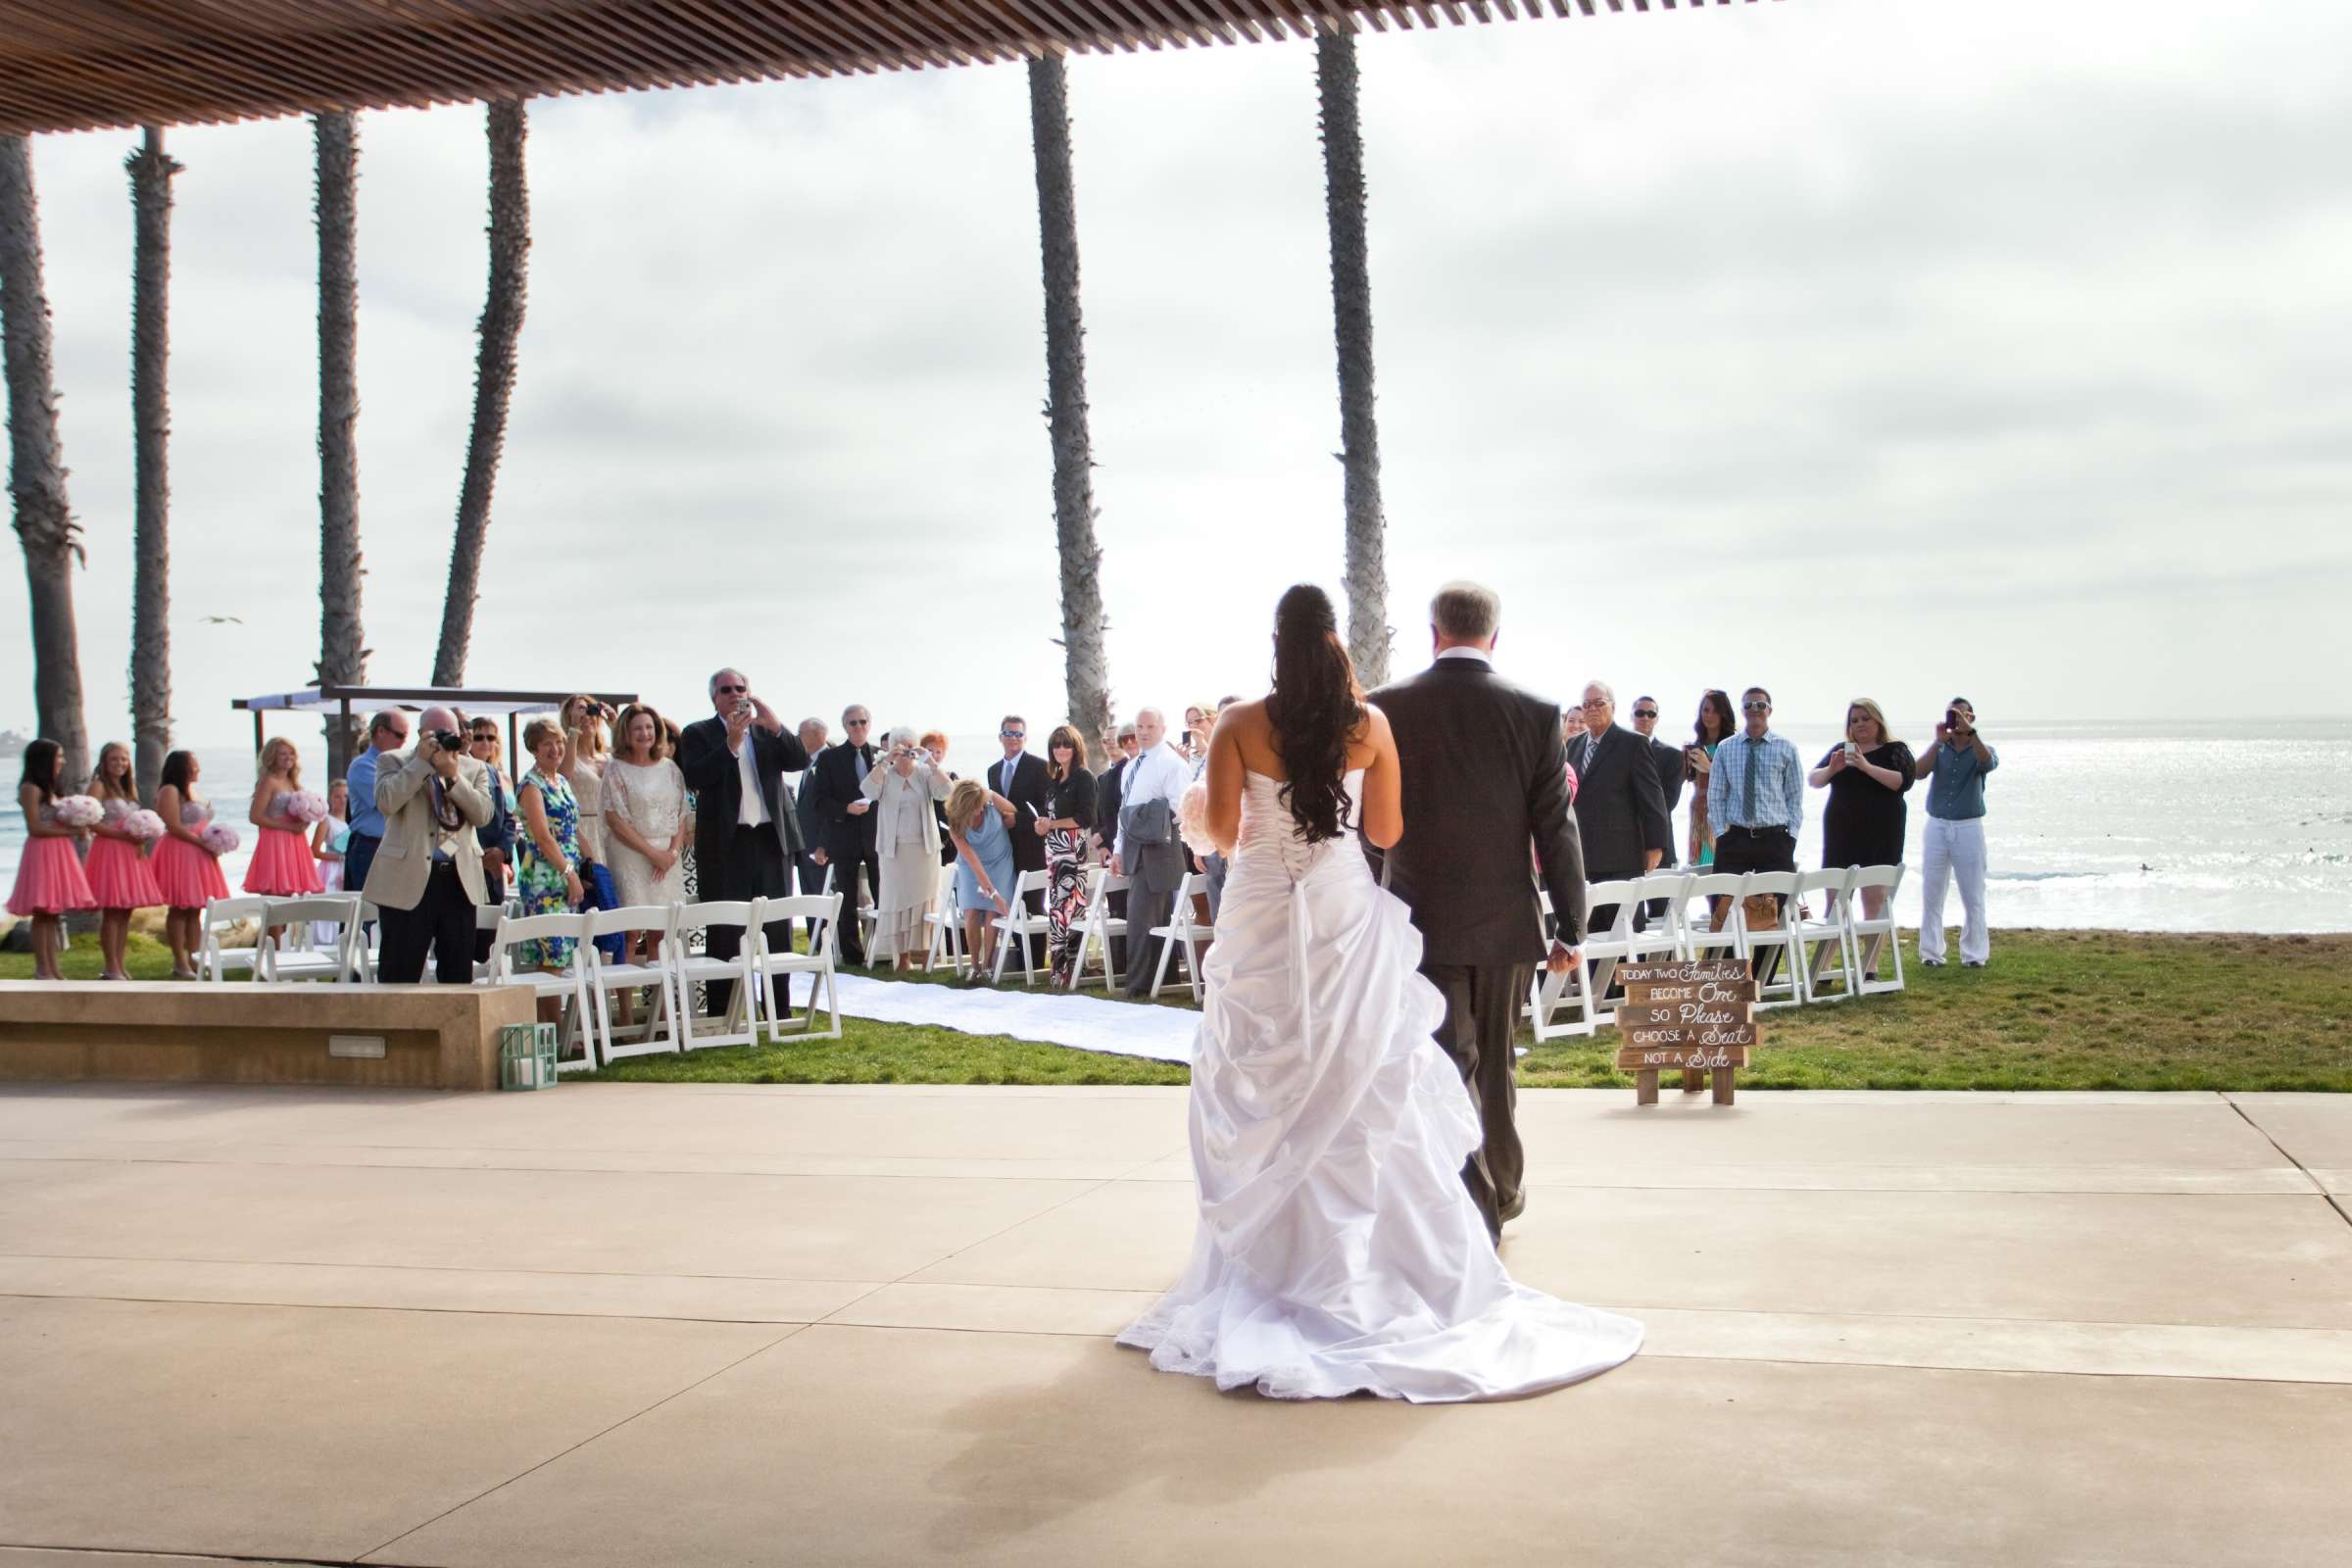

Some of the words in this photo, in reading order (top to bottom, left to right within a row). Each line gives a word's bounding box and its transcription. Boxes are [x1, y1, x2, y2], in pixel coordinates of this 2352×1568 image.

[1621, 969, 1652, 980] TODAY
[1679, 961, 1744, 982] Families
[1650, 988, 1691, 1000] BECOME
[1698, 983, 1737, 1003] One
[1650, 1009, 1670, 1021] SO
[1680, 1004, 1734, 1024] Please
[1633, 1030, 1681, 1042] CHOOSE
[1687, 1029, 1695, 1040] A
[1699, 1024, 1751, 1046] Seat
[1644, 1053, 1667, 1063] NOT
[1673, 1053, 1683, 1063] A
[1686, 1047, 1730, 1067] Side
